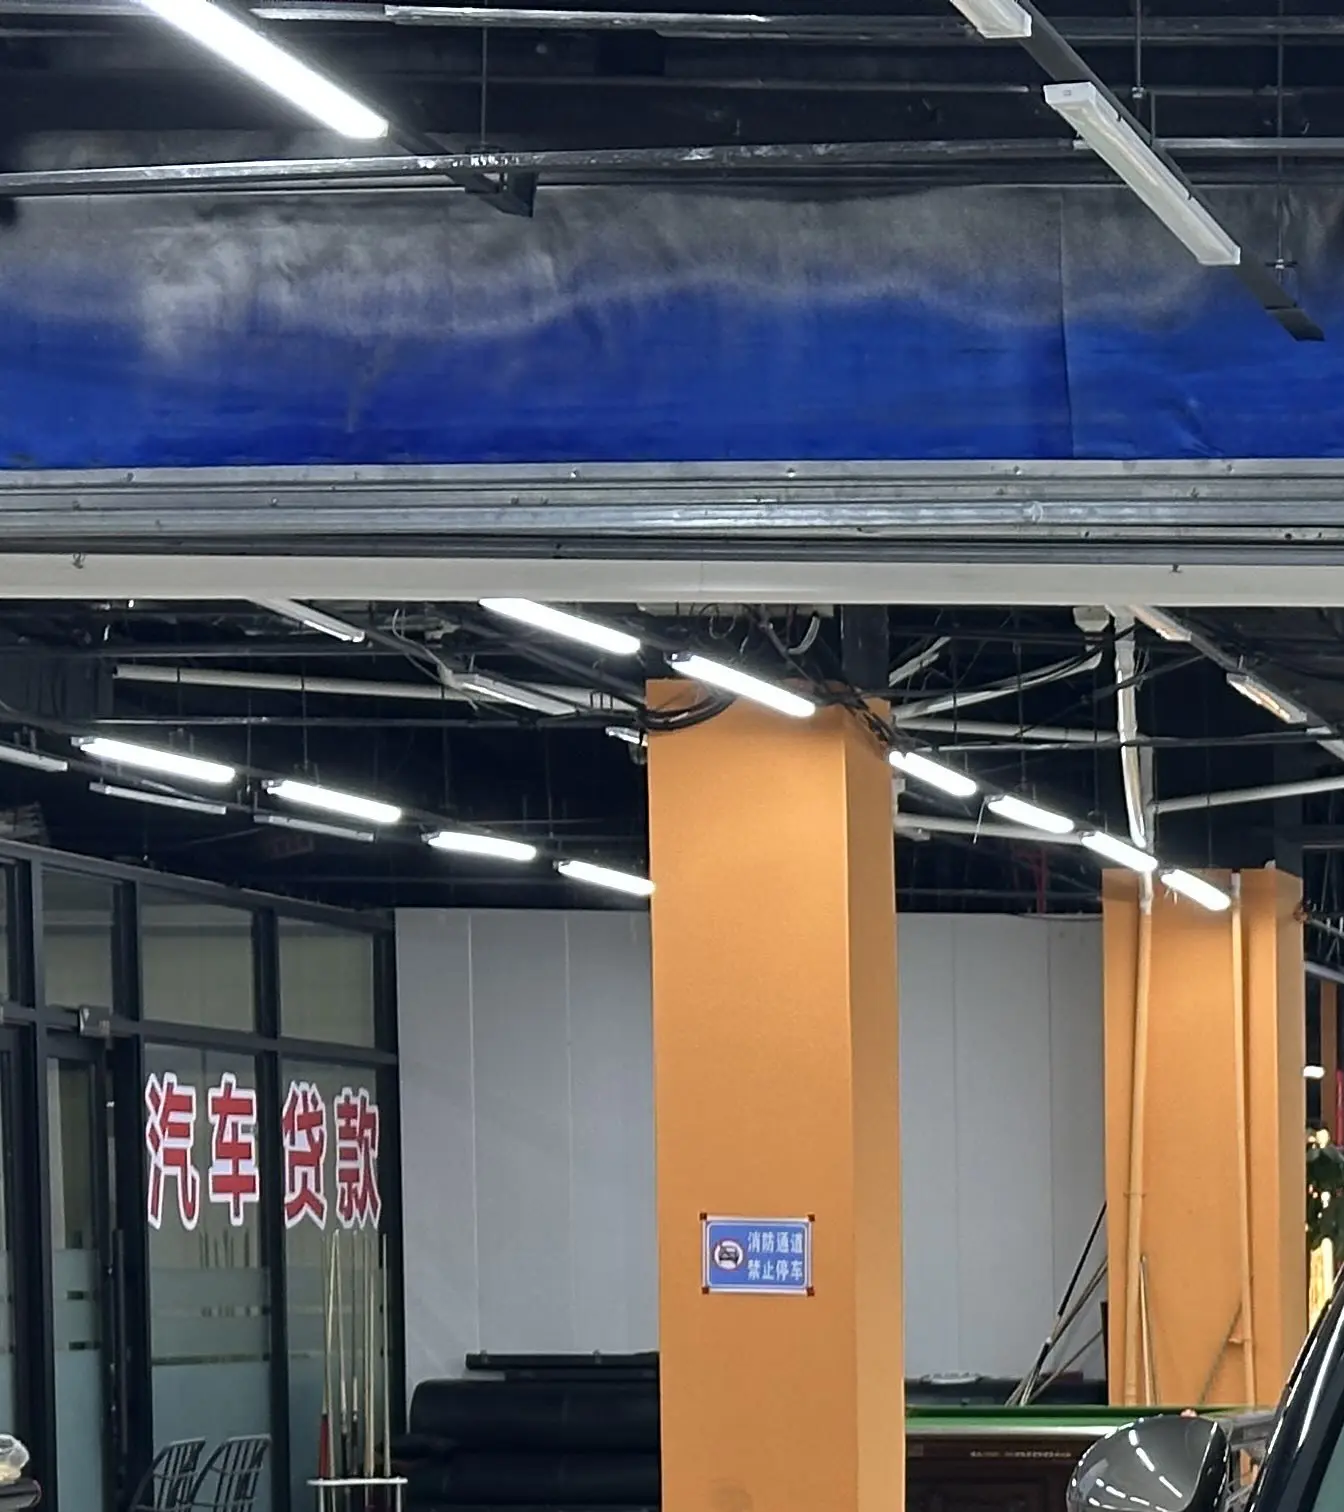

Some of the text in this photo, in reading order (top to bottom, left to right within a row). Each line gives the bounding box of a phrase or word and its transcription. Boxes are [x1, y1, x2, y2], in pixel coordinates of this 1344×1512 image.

[145, 1072, 381, 1230] 汽车贷款
[747, 1230, 804, 1254] 消防通道
[747, 1259, 804, 1282] 禁止停车
